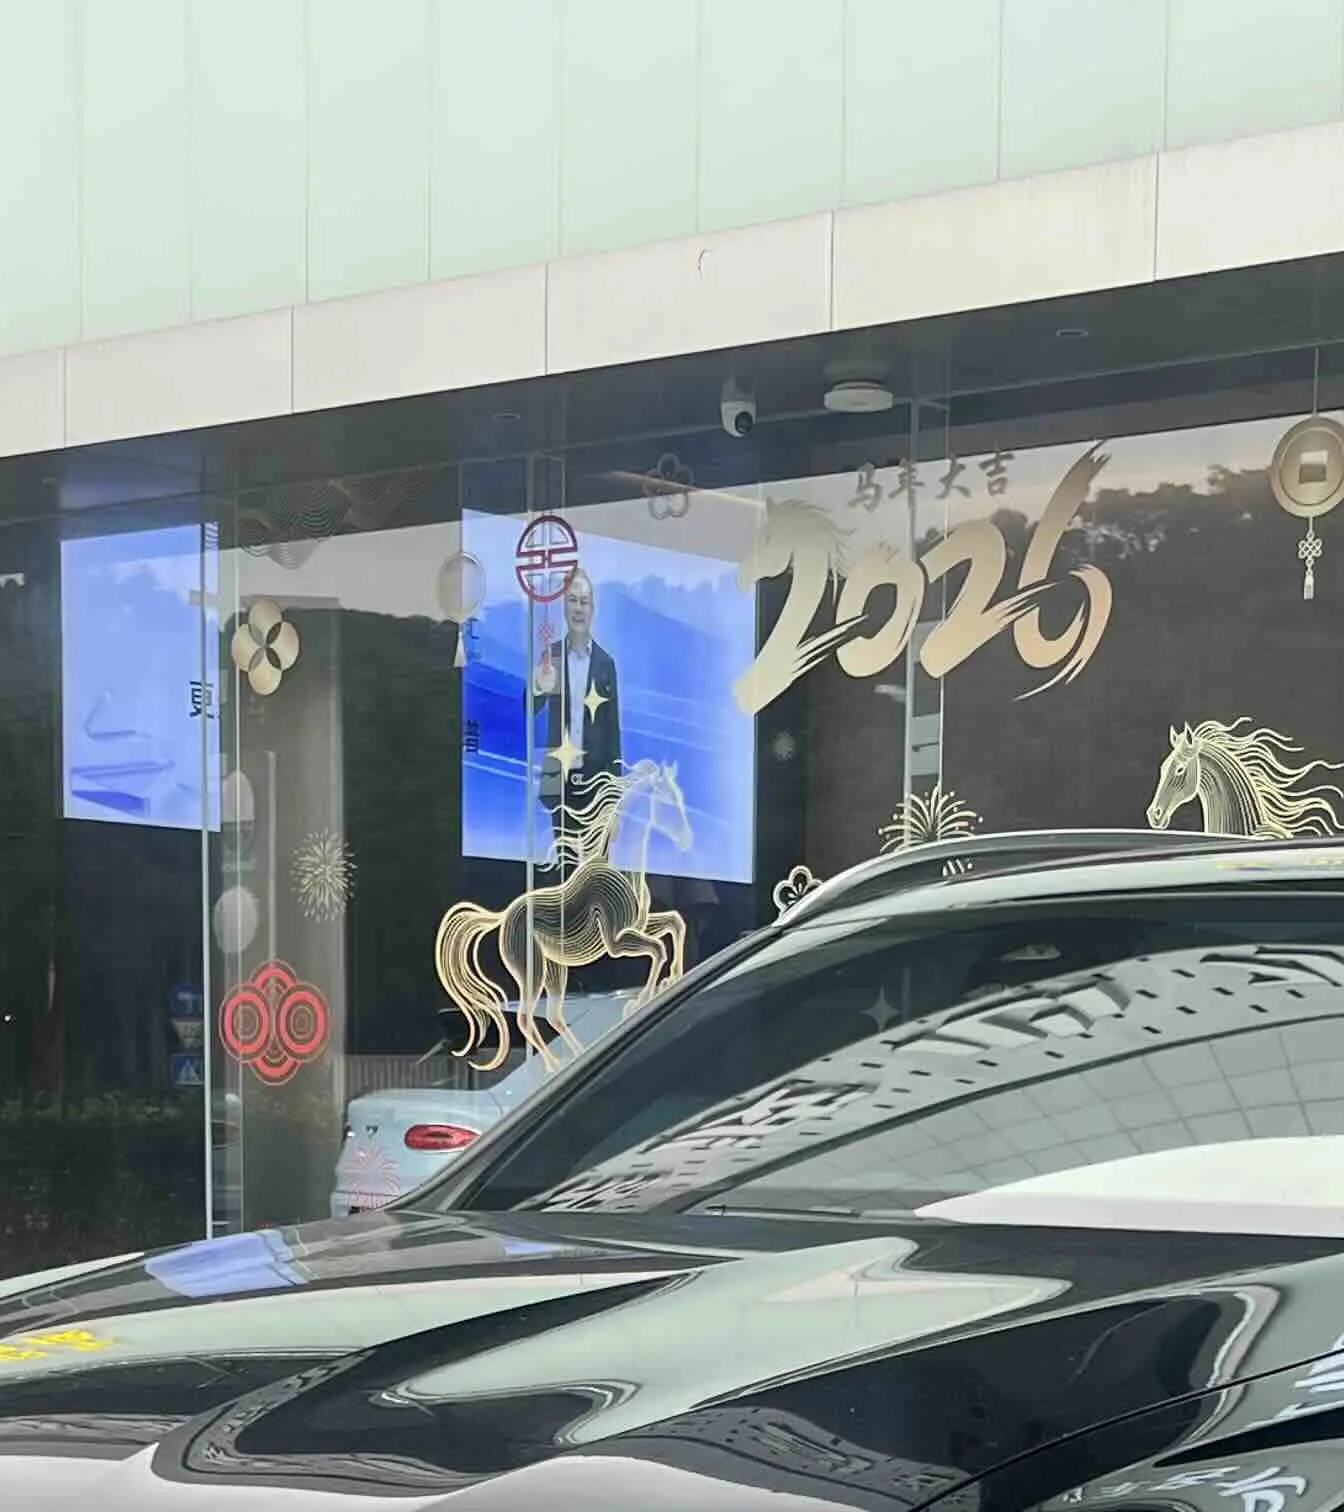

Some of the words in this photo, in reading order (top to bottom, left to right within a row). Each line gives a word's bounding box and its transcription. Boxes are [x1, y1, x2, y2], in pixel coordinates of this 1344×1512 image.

[846, 452, 1016, 515] 马年大吉
[730, 437, 1114, 718] 2026
